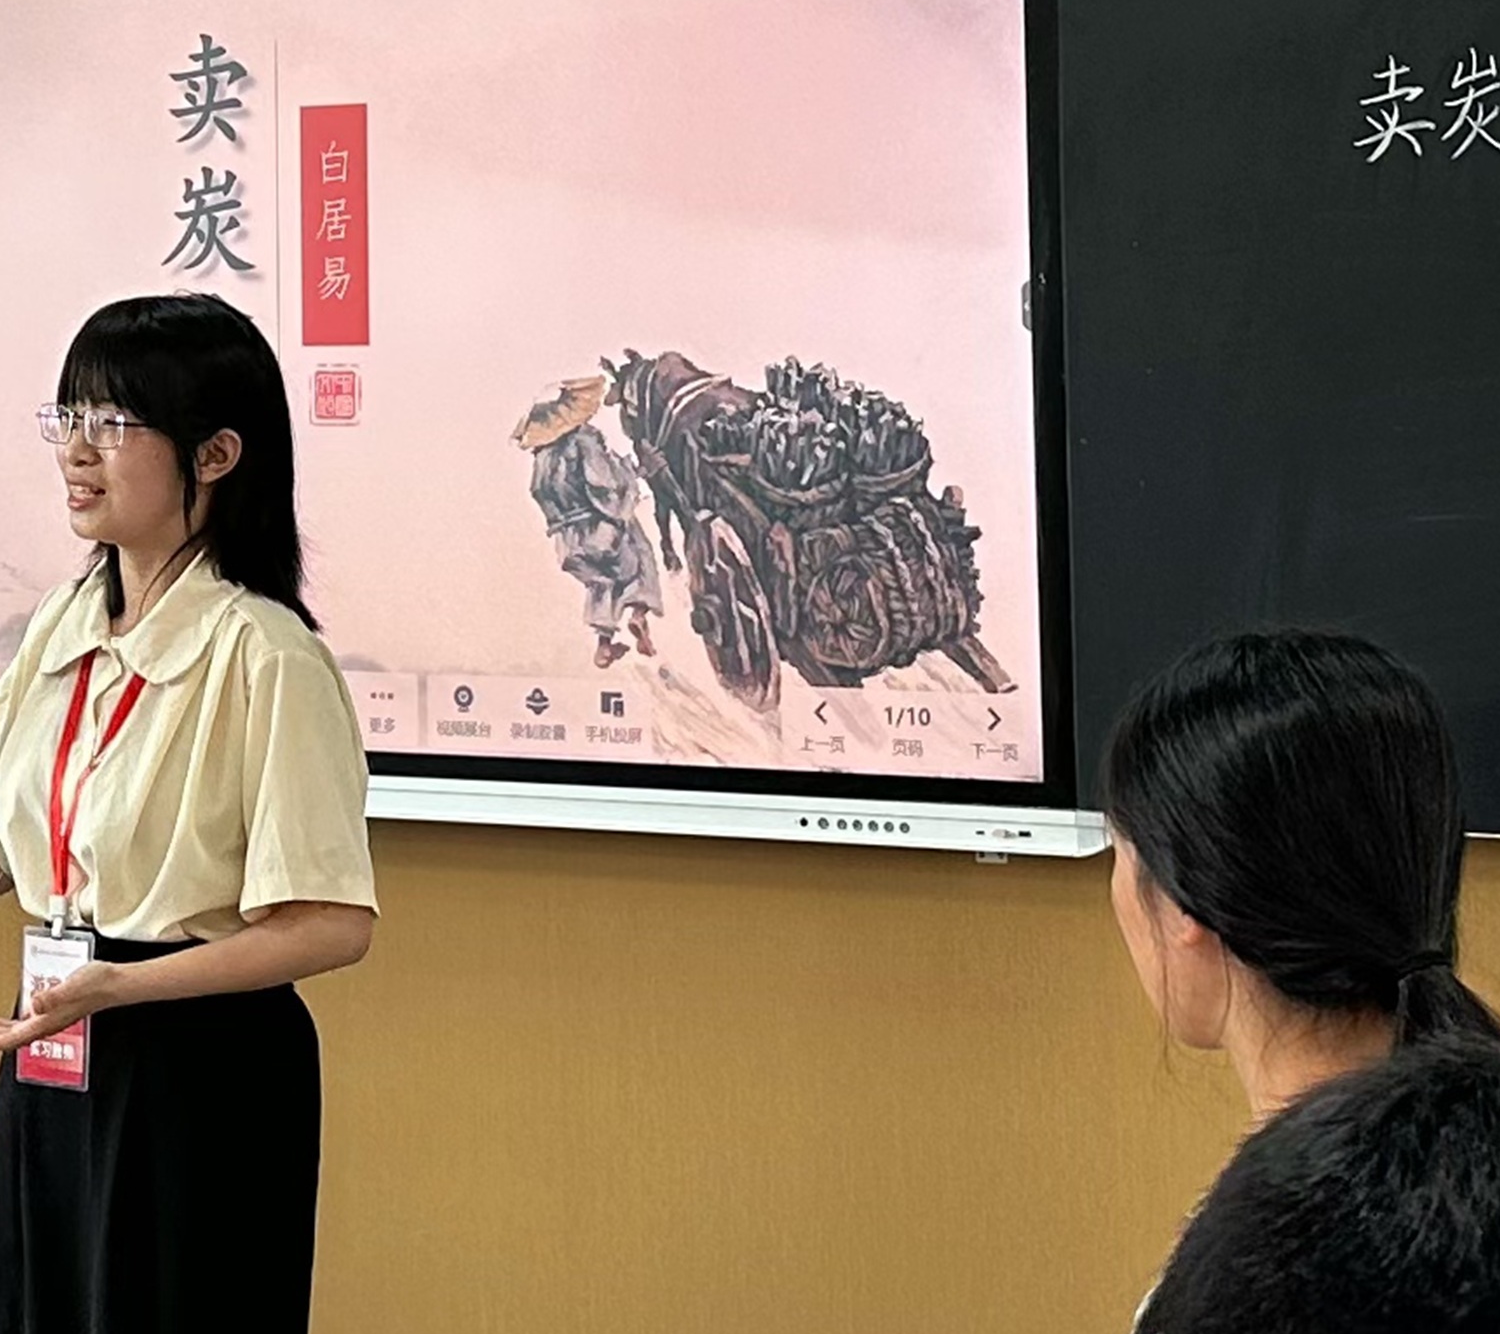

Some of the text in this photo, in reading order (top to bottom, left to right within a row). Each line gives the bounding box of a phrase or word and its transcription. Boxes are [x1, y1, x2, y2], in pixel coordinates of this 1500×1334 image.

[161, 33, 256, 270] 卖炭
[315, 140, 352, 300] 白居易
[369, 717, 396, 734] 更多
[884, 706, 931, 728] 1/10
[800, 735, 845, 754] 上一页
[891, 738, 923, 757] 页码
[971, 743, 1019, 762] 下一页
